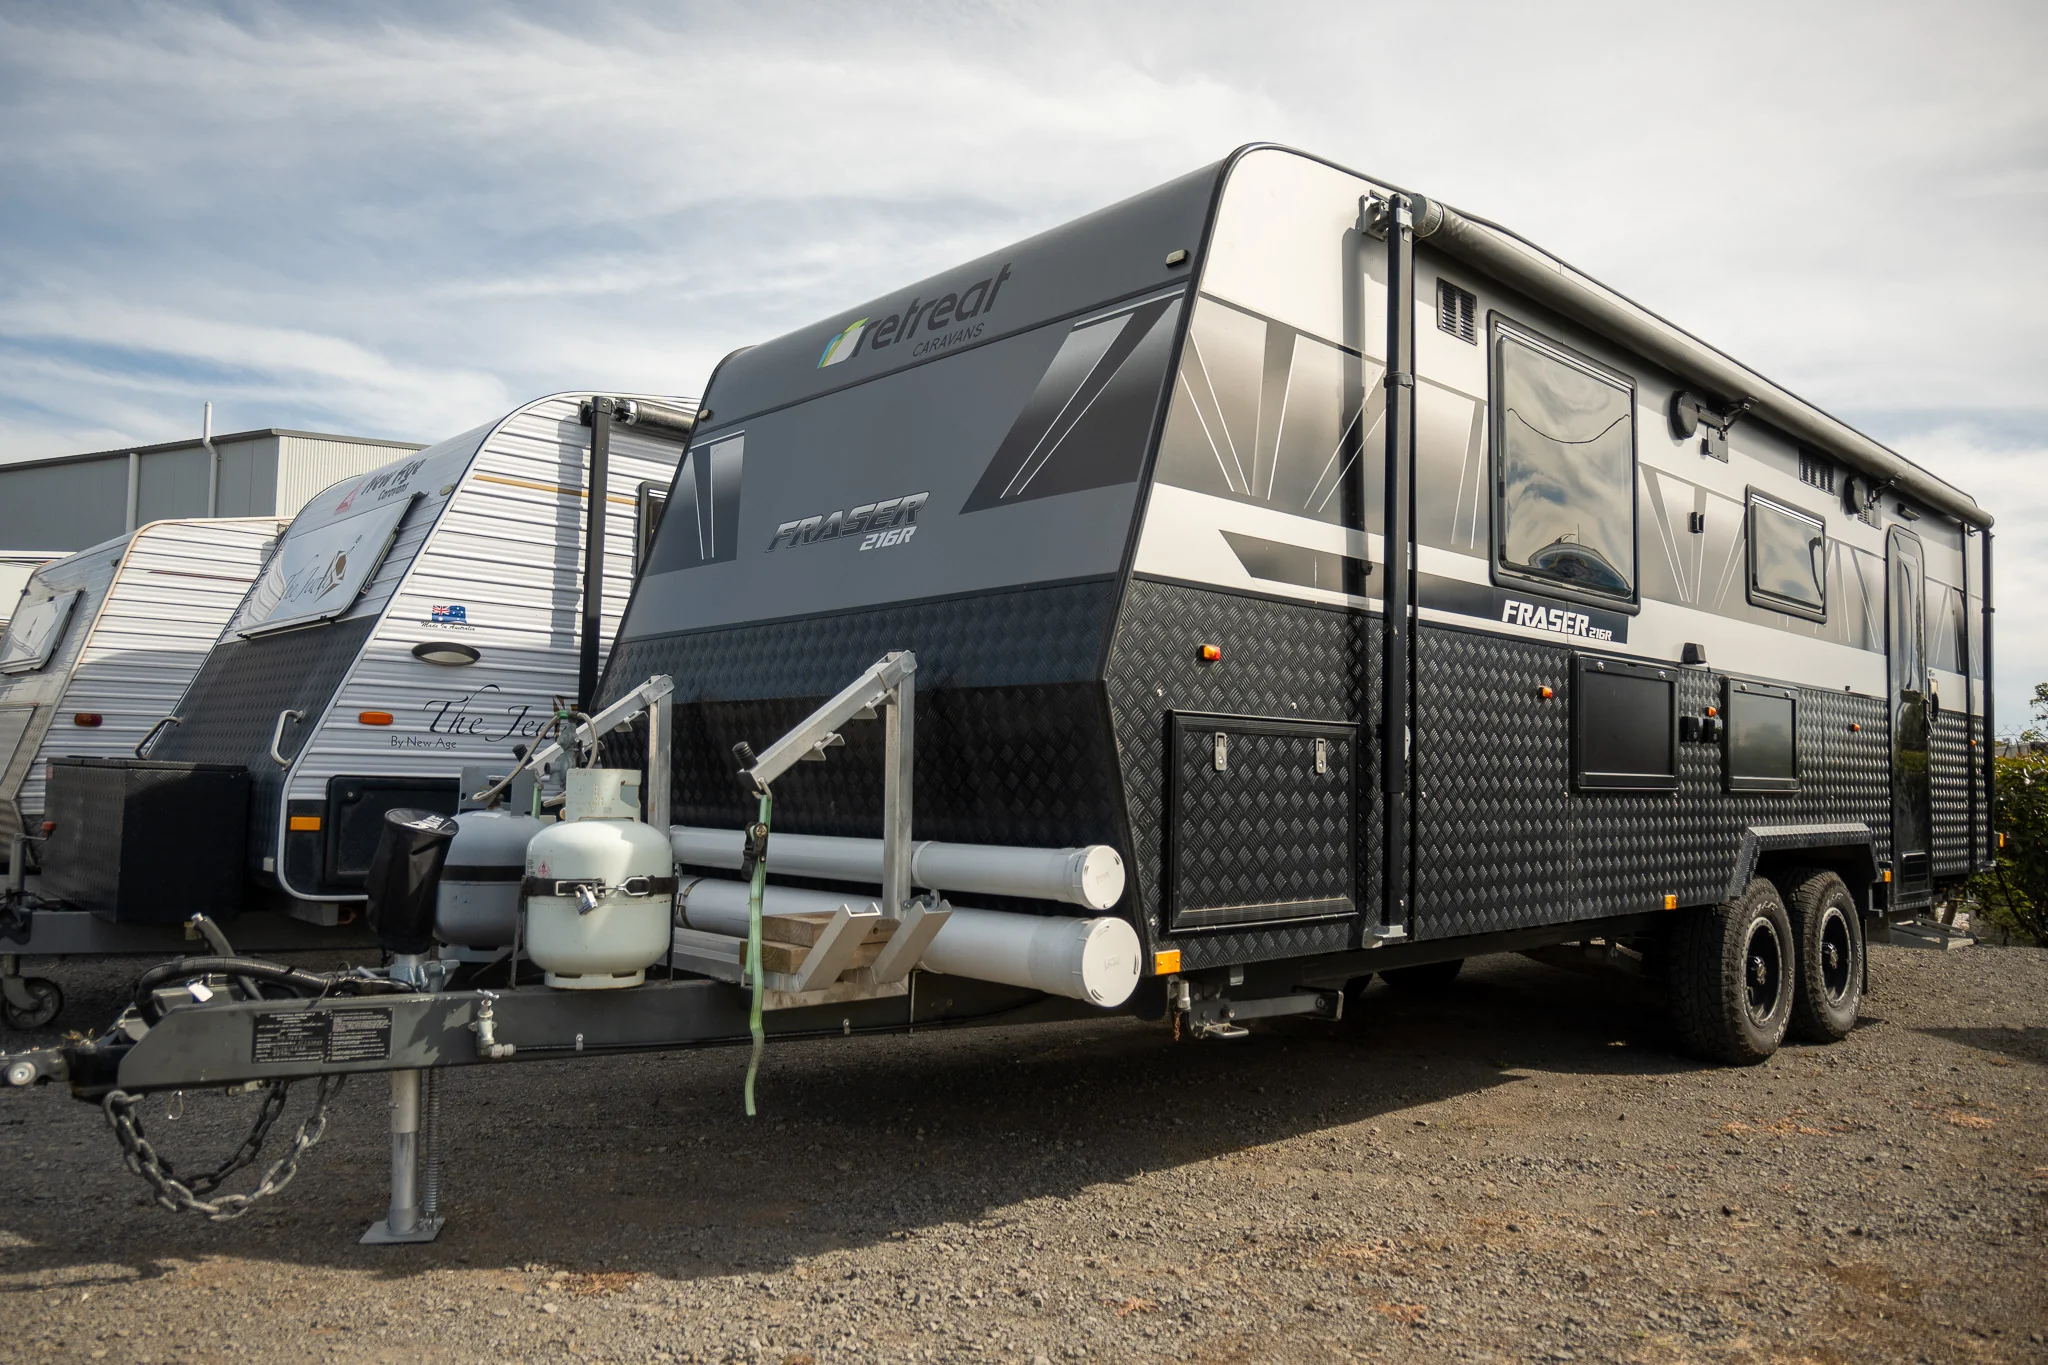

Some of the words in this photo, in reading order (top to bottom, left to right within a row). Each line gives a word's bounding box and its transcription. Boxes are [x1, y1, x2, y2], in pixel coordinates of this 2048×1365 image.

[851, 262, 1013, 359] retreat
[912, 322, 985, 358] CARAVANS
[360, 470, 397, 496] New
[391, 458, 427, 485] Age
[765, 491, 931, 554] FRASER
[859, 526, 918, 551] 216R
[1502, 599, 1590, 637] FRASER
[1588, 627, 1612, 641] 216R
[422, 684, 501, 735] The
[391, 735, 404, 749] By
[406, 736, 432, 748] New
[435, 737, 457, 750] Age
